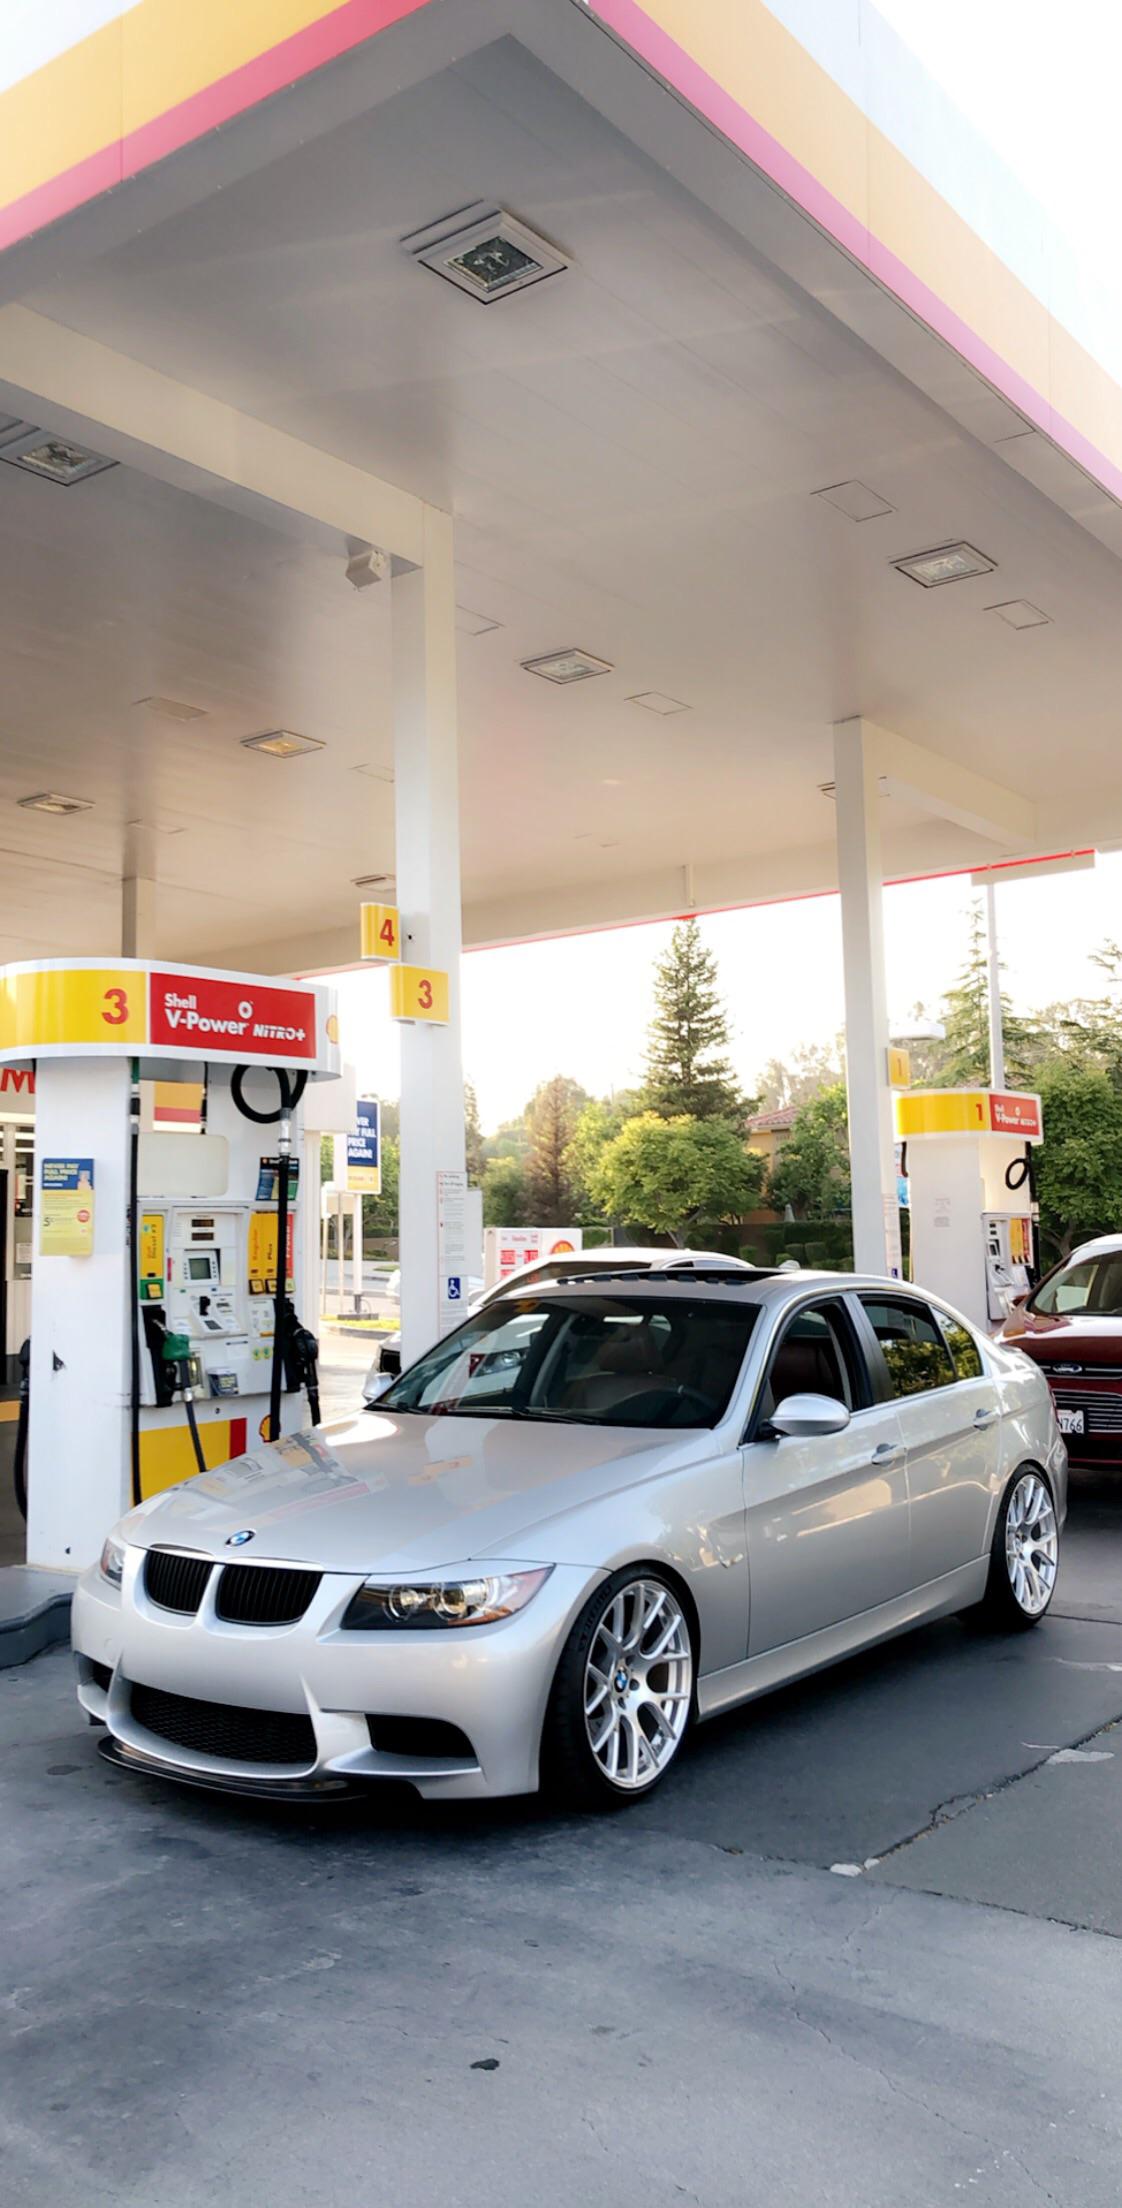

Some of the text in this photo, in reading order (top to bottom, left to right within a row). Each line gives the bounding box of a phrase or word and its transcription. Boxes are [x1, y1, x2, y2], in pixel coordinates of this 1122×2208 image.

[380, 918, 395, 947] 4
[101, 988, 129, 1025] 3
[164, 992, 197, 1010] Shell
[417, 979, 433, 1009] 3
[164, 1008, 247, 1035] V-Power
[897, 1058, 902, 1077] 1
[975, 1103, 983, 1121] 1
